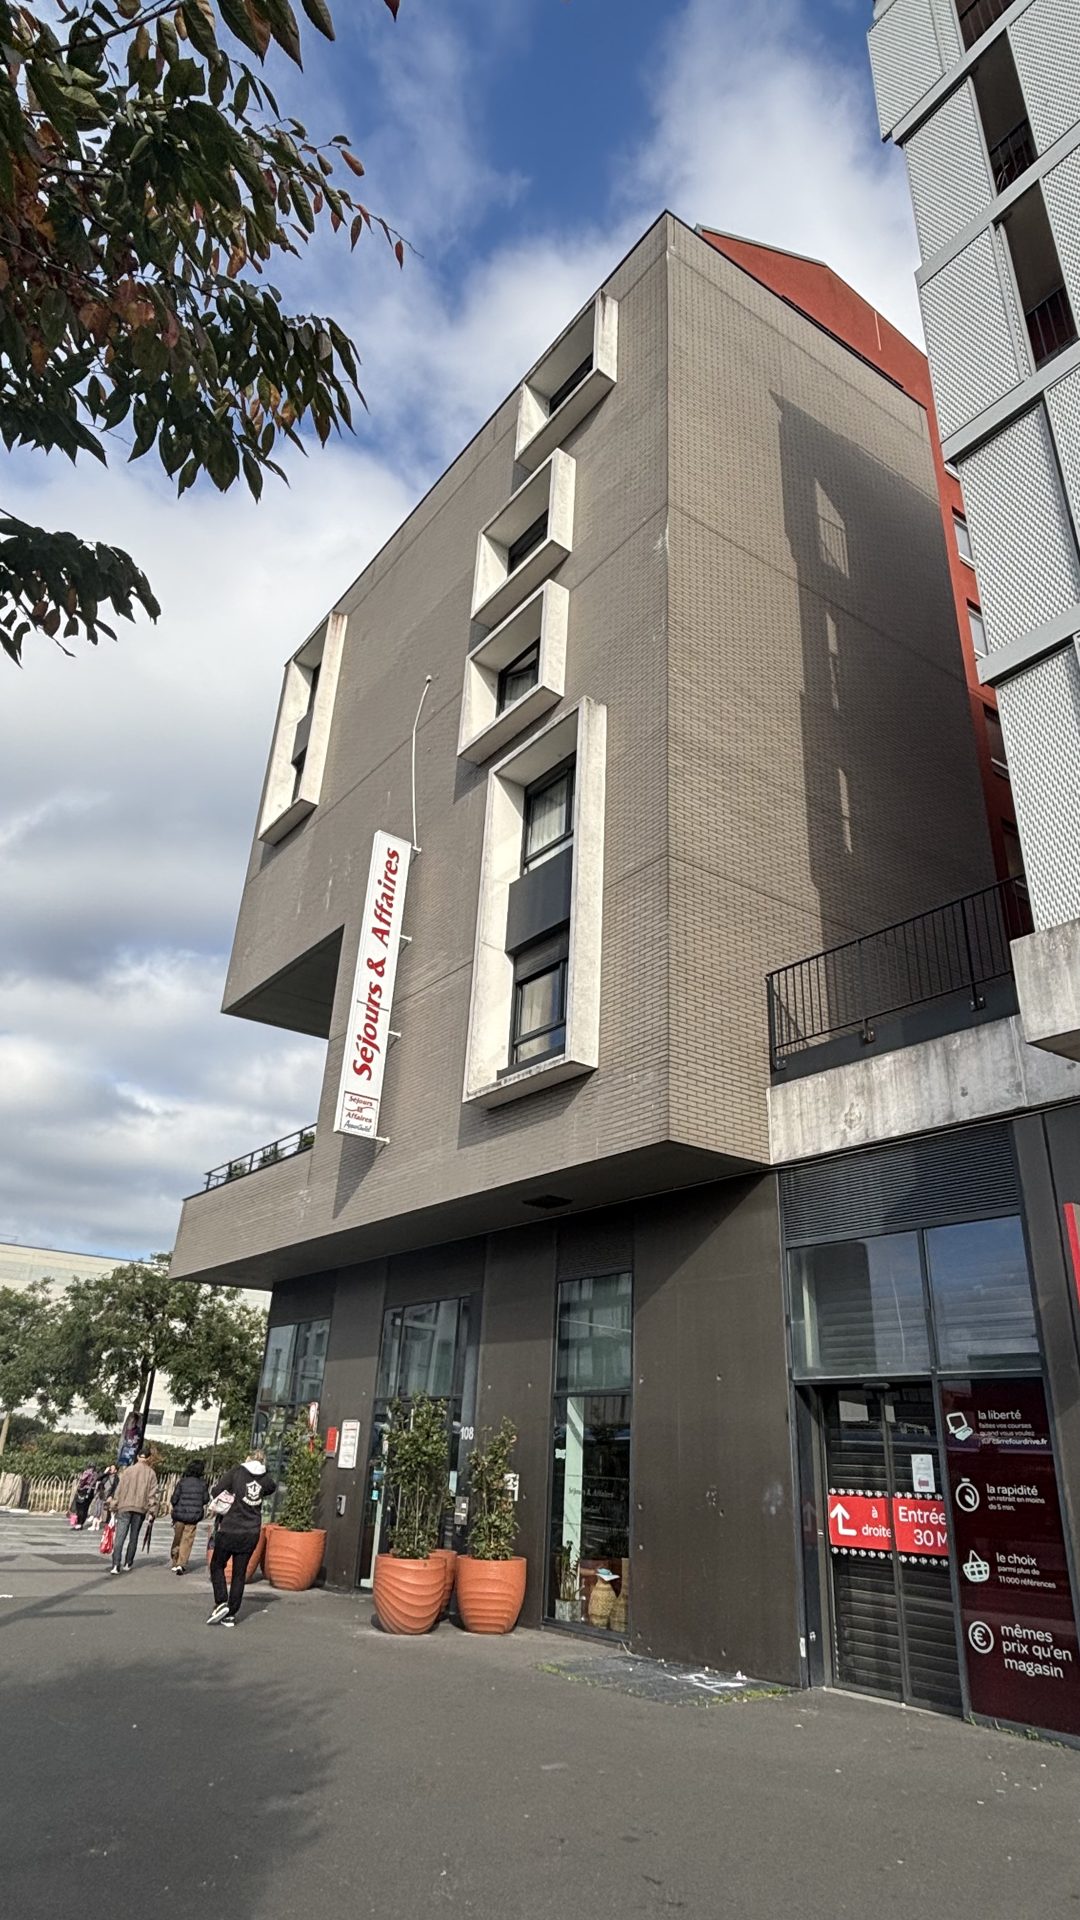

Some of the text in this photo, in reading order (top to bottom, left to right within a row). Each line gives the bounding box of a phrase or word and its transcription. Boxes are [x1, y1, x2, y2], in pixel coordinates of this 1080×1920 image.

[352, 847, 400, 1081] Séjours & Affaires
[346, 1111, 372, 1123] Affaires
[977, 1409, 1022, 1420] la liberté
[460, 1426, 474, 1440] 108
[985, 1482, 1039, 1497] la rapidité
[871, 1506, 878, 1519] à
[898, 1506, 947, 1526] Entrée
[861, 1524, 892, 1538] droite
[913, 1529, 934, 1547] 30
[995, 1552, 1038, 1567] le choix
[1020, 1578, 1057, 1589] références
[1000, 1623, 1053, 1643] mêmes
[1002, 1640, 1072, 1662] prix qu'en
[1004, 1658, 1064, 1678] magasin
